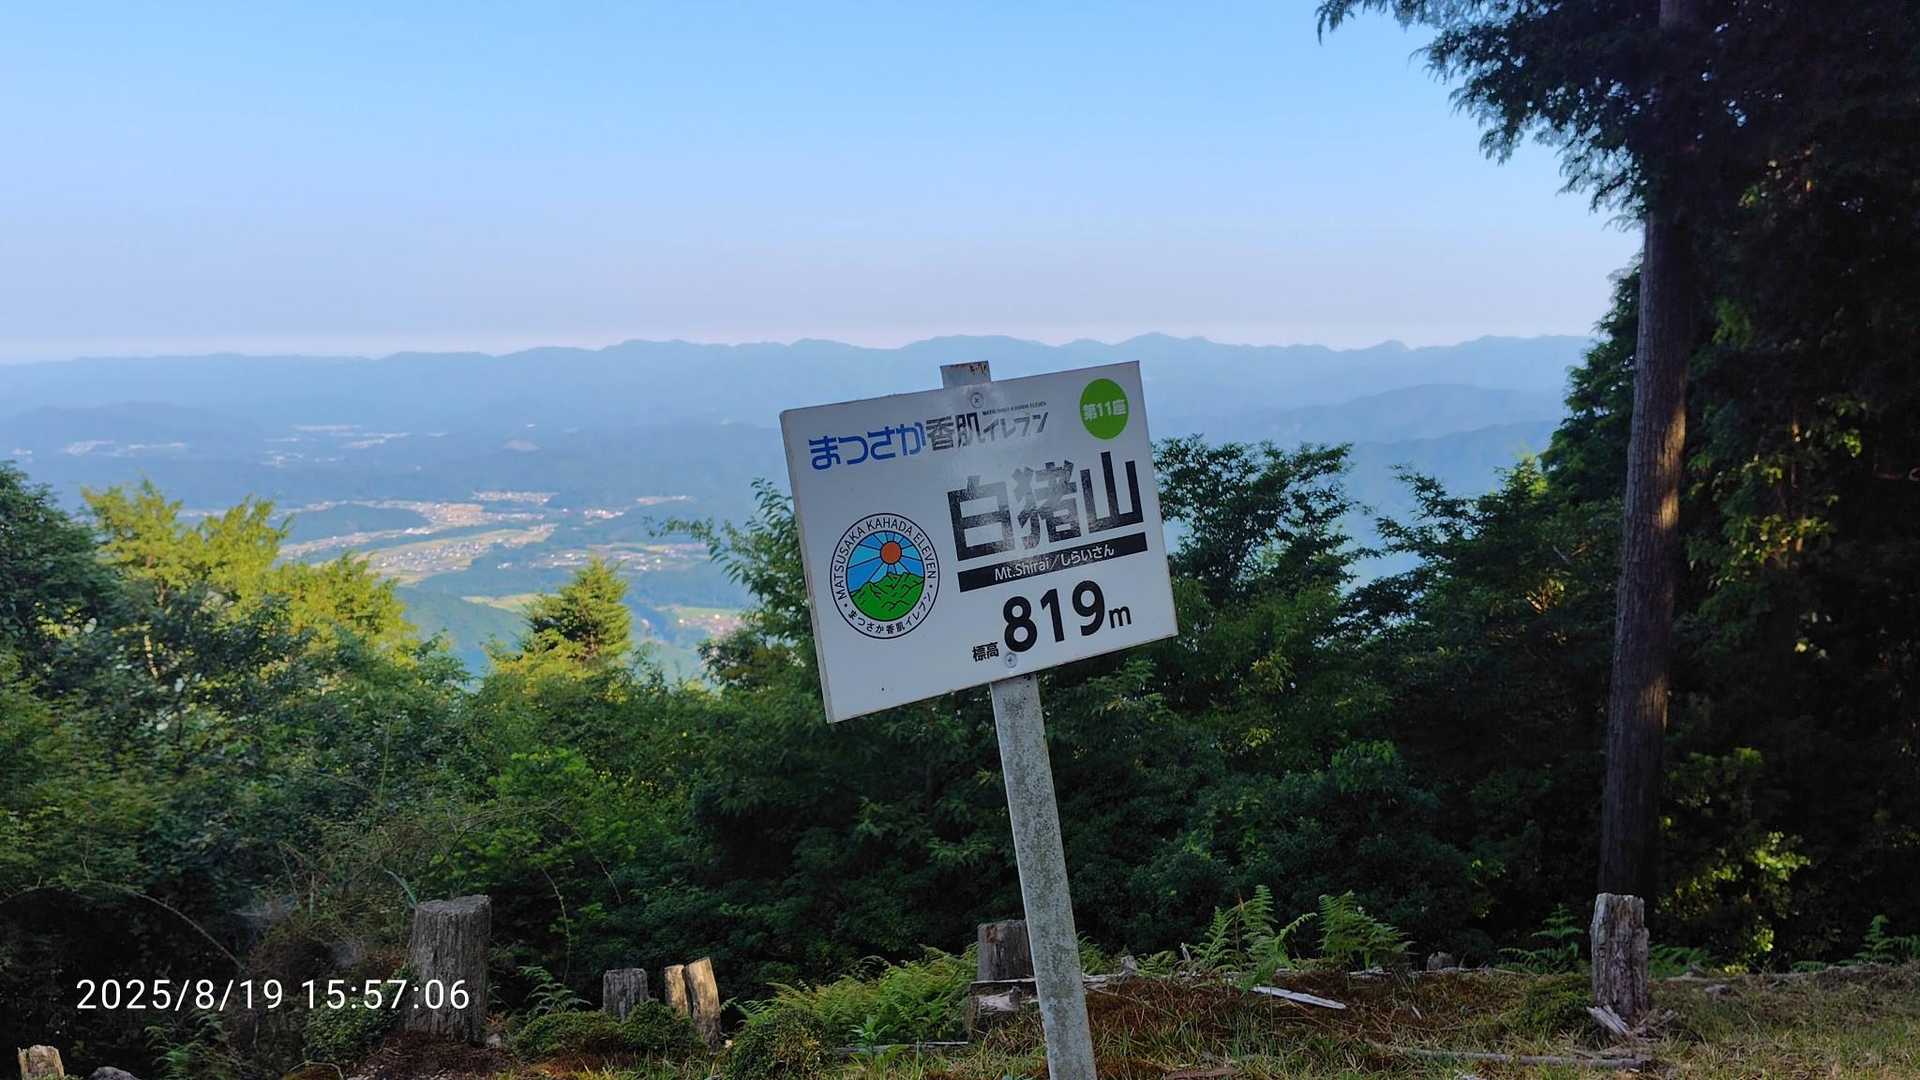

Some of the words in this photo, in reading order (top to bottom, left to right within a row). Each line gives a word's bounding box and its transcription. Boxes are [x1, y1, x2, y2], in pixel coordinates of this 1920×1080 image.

[1083, 399, 1127, 421] 第11座
[947, 451, 1144, 562] 白猪山
[834, 526, 866, 601] MATSUSAKA
[866, 517, 913, 536] KAHADA
[913, 534, 937, 579] ELEVEN
[972, 642, 1000, 662] 標高
